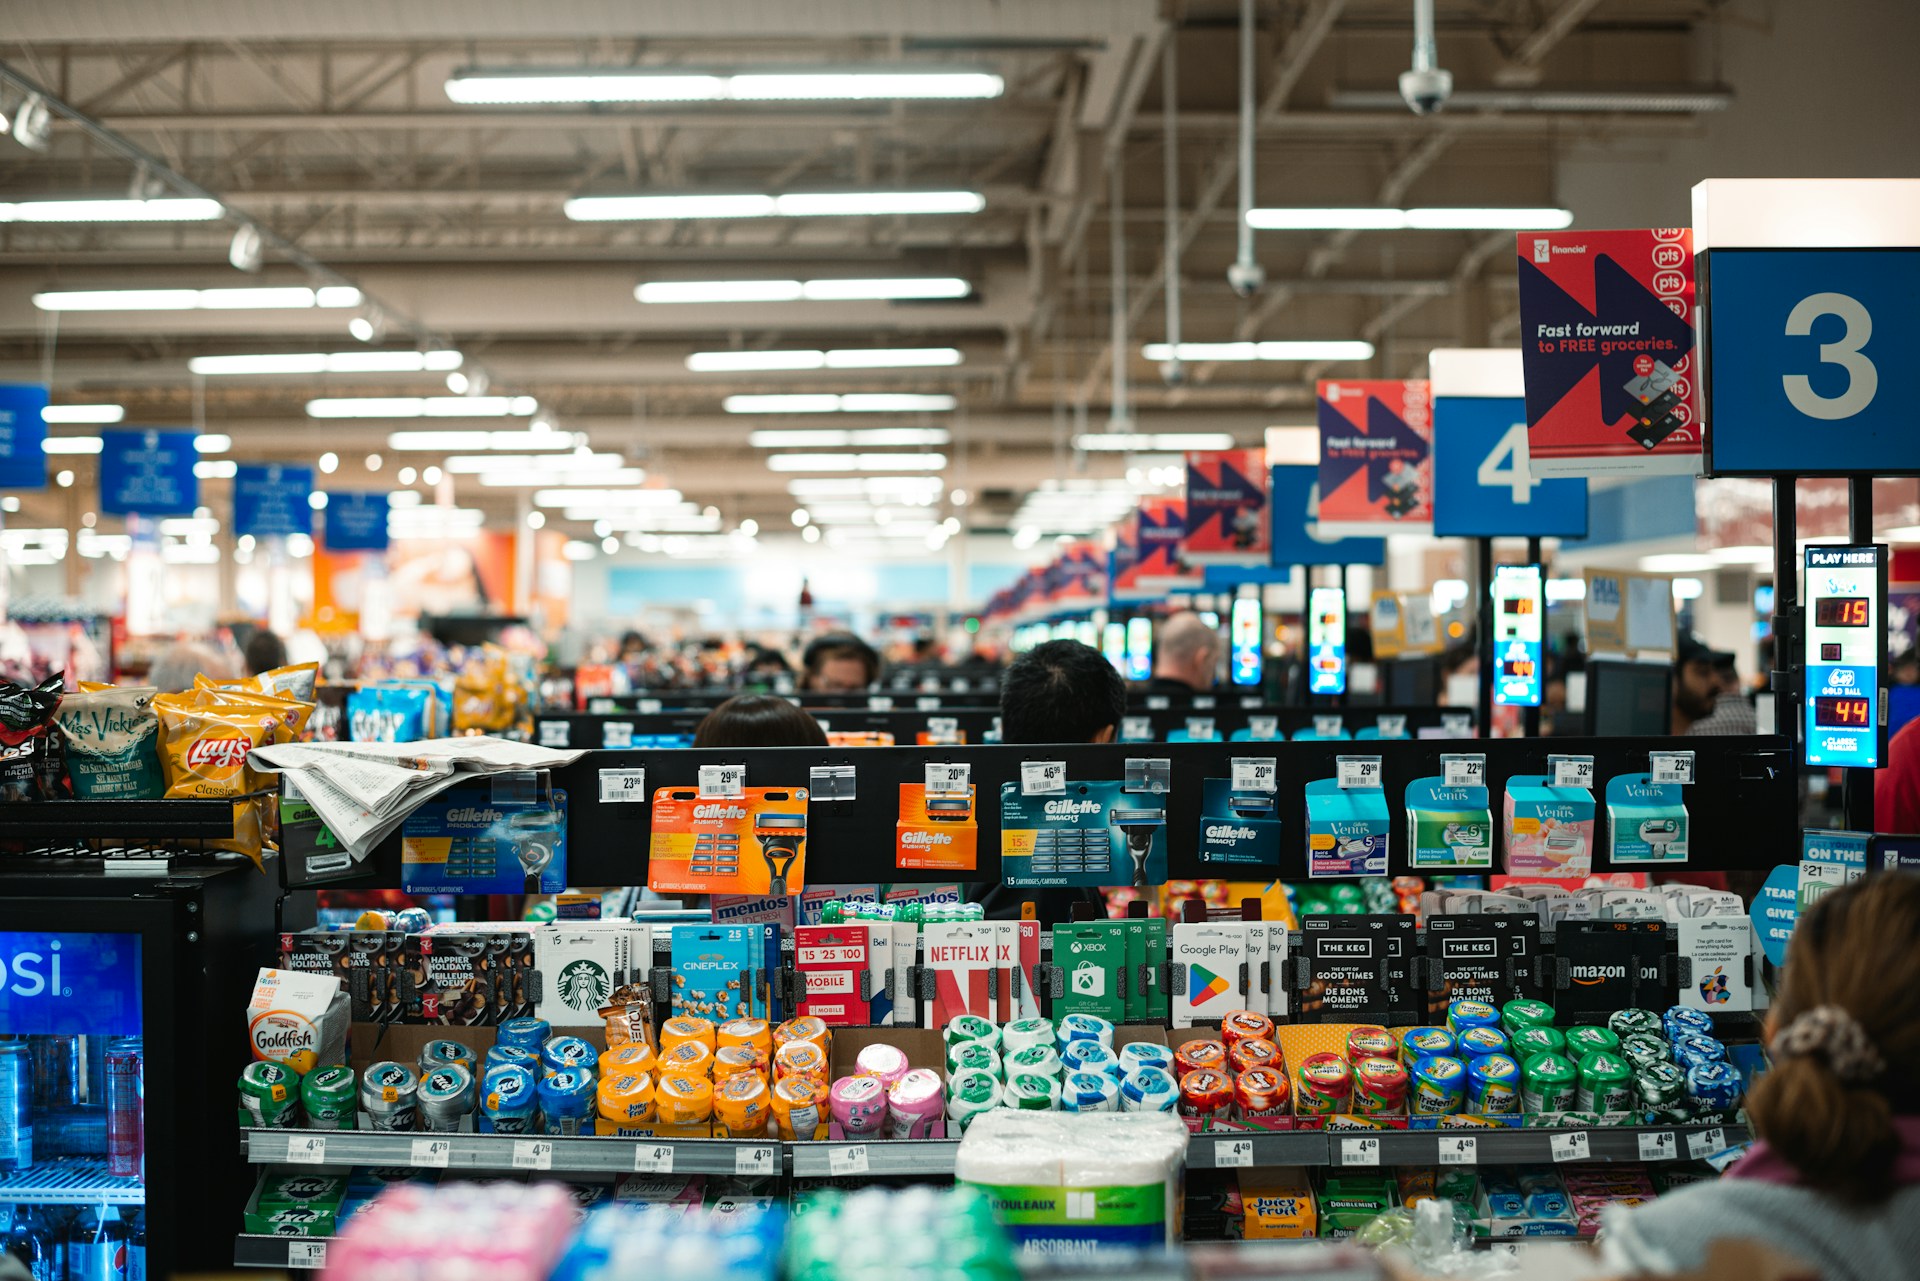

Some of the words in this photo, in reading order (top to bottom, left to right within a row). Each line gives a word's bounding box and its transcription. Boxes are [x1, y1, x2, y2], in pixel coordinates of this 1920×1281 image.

[1552, 245, 1585, 254] financial
[1659, 249, 1679, 265] pts
[1660, 276, 1679, 291] pts
[1537, 324, 1571, 338] Fast
[1576, 322, 1639, 337] forward
[1538, 340, 1554, 353] to
[1560, 338, 1596, 352] FREE
[1601, 337, 1678, 355] groceries.
[1783, 292, 1878, 420] 3
[1327, 436, 1354, 448] Fast
[1358, 436, 1397, 448] forward
[1477, 423, 1541, 504] 4
[1812, 553, 1841, 564] PLAY
[1843, 553, 1874, 564] HERE
[1842, 602, 1866, 624] 15
[1822, 687, 1843, 695] GOLD
[1836, 702, 1867, 722] 44
[60, 711, 92, 740] Miss
[91, 707, 148, 741] Vickie's
[190, 737, 249, 768] Lay's
[195, 784, 234, 796] Classic
[1430, 788, 1468, 801] Venus
[693, 804, 746, 819] Gillette
[1044, 799, 1101, 814] Gillette
[1536, 805, 1574, 818] Venus
[446, 808, 503, 822] Gillette
[1205, 825, 1257, 840] Gillette
[1330, 822, 1370, 835] Venus
[315, 825, 336, 848] 4
[901, 832, 952, 845] Gillette
[1204, 852, 1210, 861] 5
[1808, 848, 1831, 860] ON
[1834, 850, 1864, 862] THE
[1803, 865, 1822, 876] $21
[653, 881, 657, 889] 8
[1007, 877, 1015, 885] 15
[1765, 887, 1796, 899] TEAR
[717, 896, 789, 921] mentos
[1766, 908, 1794, 919] GIVE
[760, 910, 781, 922] FRESH
[1020, 926, 1033, 937] $60
[1250, 929, 1263, 937] $25
[1270, 927, 1284, 935] $50
[1614, 923, 1627, 931] $25
[1770, 928, 1793, 938] GET
[552, 935, 562, 945] 15
[728, 929, 741, 939] 25
[873, 938, 887, 946] Bell
[1324, 944, 1343, 952] THE
[1347, 944, 1366, 952] KEG
[1449, 944, 1468, 952] THE
[1471, 944, 1491, 952] KEG
[931, 946, 990, 963] NETFLIX
[1180, 944, 1216, 956] Google
[1219, 945, 1240, 956] Play
[291, 953, 329, 962] HAPPIER
[431, 956, 469, 964] HAPPIER
[289, 960, 333, 968] HOLIDAYS
[428, 963, 472, 971] HOLIDAYS
[683, 961, 738, 970] CINEPLEX
[428, 972, 474, 980] MEILLEURS
[1317, 972, 1345, 980] GOOD
[1347, 971, 1374, 979] TIMES
[1443, 972, 1470, 980] GOOD
[1472, 971, 1499, 979] TIMES
[1570, 964, 1626, 979] mazon
[806, 977, 844, 986] MOBILE
[1466, 987, 1492, 995] BONS
[1322, 995, 1369, 1004] MOMENTS
[1449, 995, 1494, 1003] MOMENTS
[256, 1030, 312, 1049] Goldfish
[382, 1067, 404, 1086] excel
[495, 1076, 523, 1095] excel
[1418, 1092, 1455, 1107] Trident
[1420, 1104, 1441, 1113] VIBES
[1490, 1103, 1509, 1113] VIBES
[278, 1179, 338, 1193] excel
[623, 1180, 684, 1194] WHITE
[992, 1200, 1056, 1211] ROULEAUX
[1253, 1197, 1296, 1209] Juicy
[1330, 1200, 1378, 1210] DOUBLEMINT
[268, 1210, 330, 1223] excel
[1258, 1207, 1297, 1217] Fruit
[1504, 1226, 1528, 1235] excel
[1023, 1239, 1098, 1256] ABSORBANT
